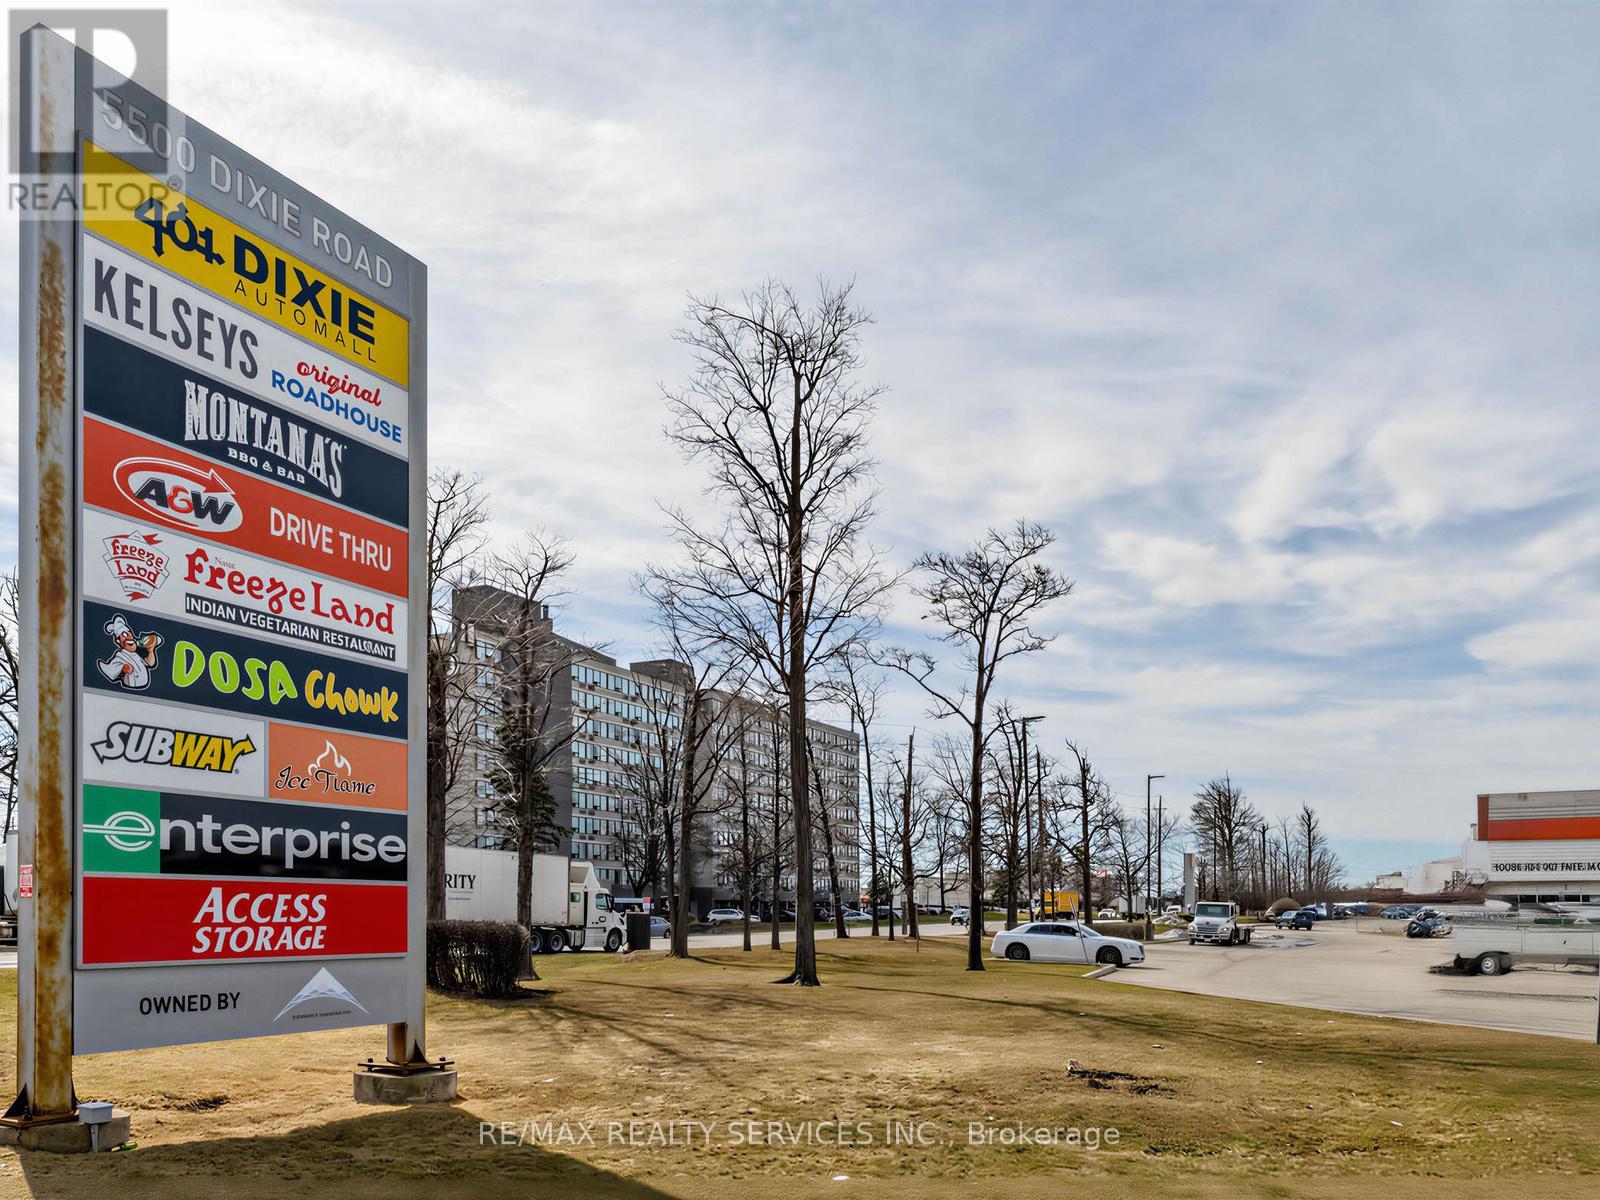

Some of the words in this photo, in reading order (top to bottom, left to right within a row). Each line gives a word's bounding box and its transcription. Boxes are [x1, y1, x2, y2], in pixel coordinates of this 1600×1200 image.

[102, 87, 196, 173] 5500
[209, 153, 302, 238] DIXIE
[312, 216, 393, 289] ROAD
[134, 197, 225, 265] 401
[234, 235, 375, 345] DIXIE
[94, 258, 258, 379] KELSEYS
[234, 279, 376, 362] AUTOMALL
[271, 369, 402, 443] ROADHOUSE
[296, 361, 382, 407] original
[184, 379, 343, 498] MONTANA'S
[134, 477, 235, 525] A&W
[270, 506, 334, 555] DRIVE
[339, 530, 392, 572] THRU
[186, 597, 236, 621] INDIAN
[240, 609, 320, 641] VEGETARIAN
[172, 640, 298, 705] DOSA
[90, 720, 257, 773] SUBWAY
[192, 925, 327, 953] STORAGE
[139, 994, 212, 1015] OWNED
[217, 991, 241, 1010] BY
